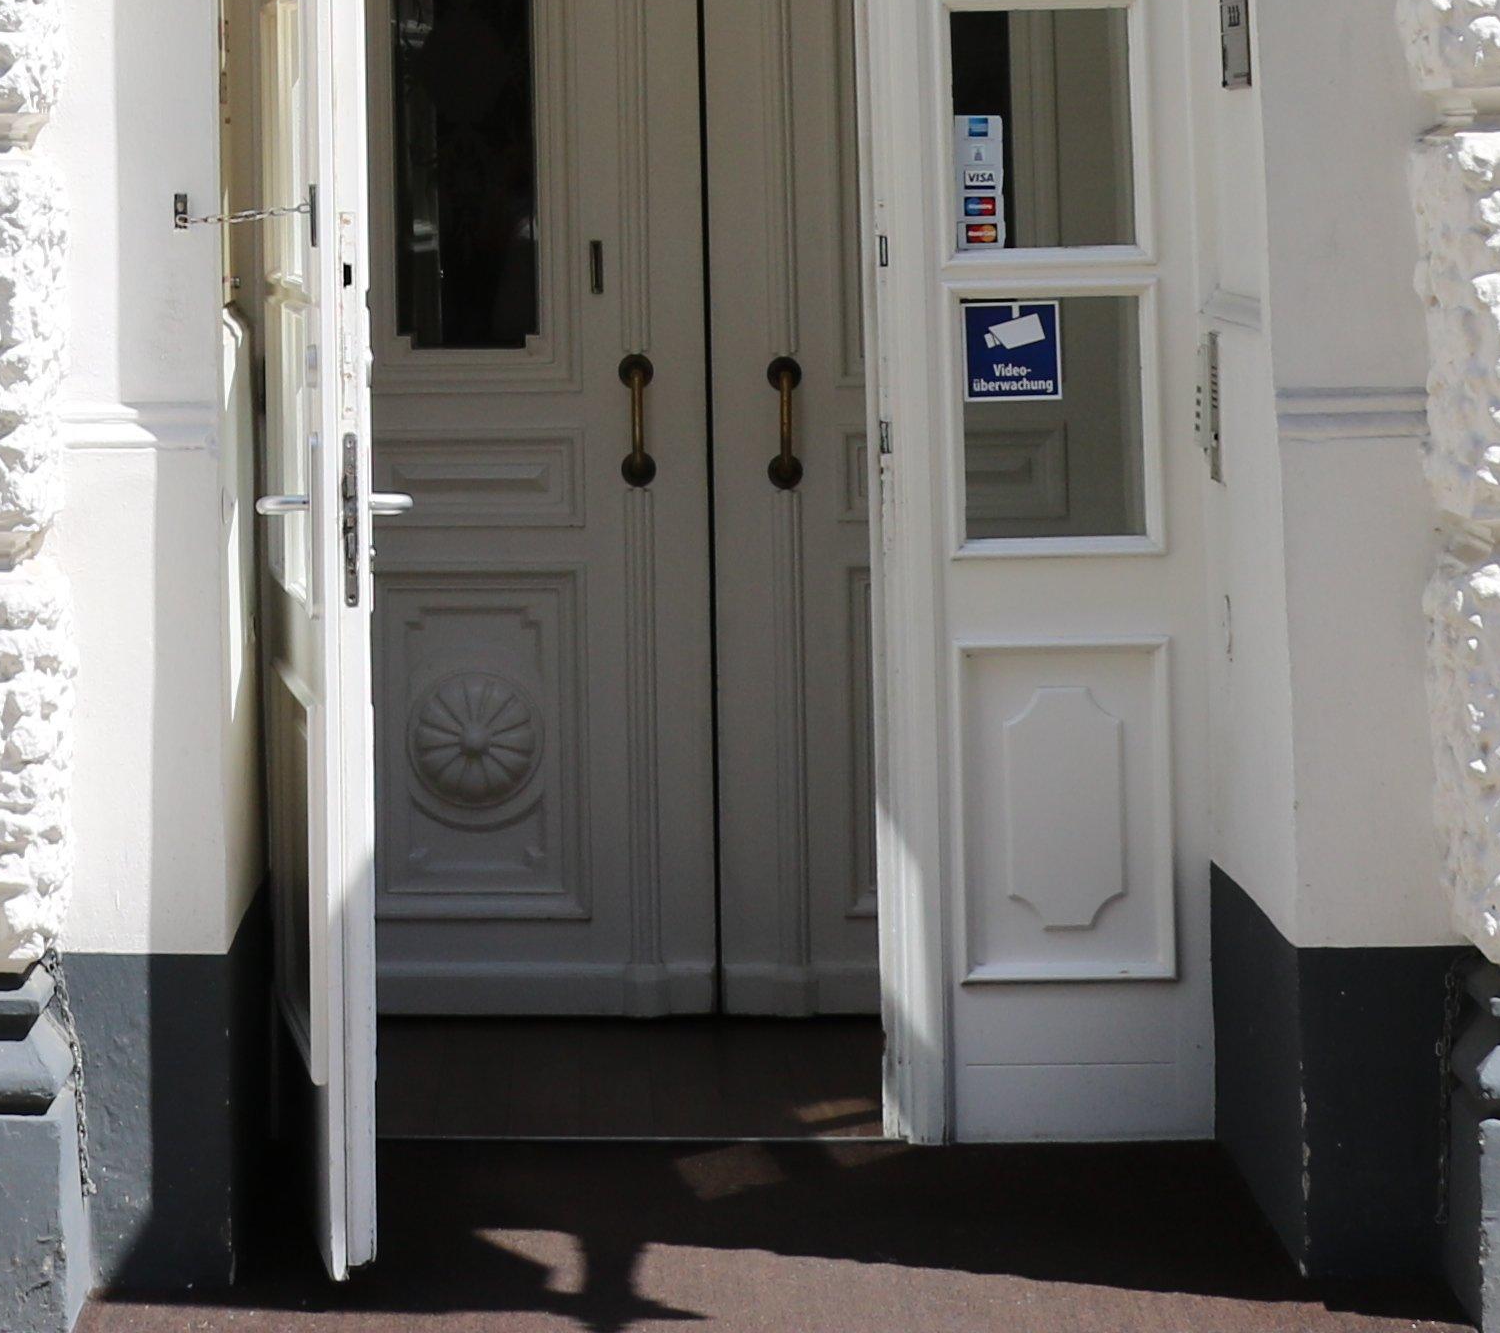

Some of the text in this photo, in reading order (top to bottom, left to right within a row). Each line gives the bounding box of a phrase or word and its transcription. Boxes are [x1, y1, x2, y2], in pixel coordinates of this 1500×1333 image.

[968, 173, 995, 183] VISA
[992, 362, 1032, 377] Video-
[973, 377, 1054, 393] überwachung
